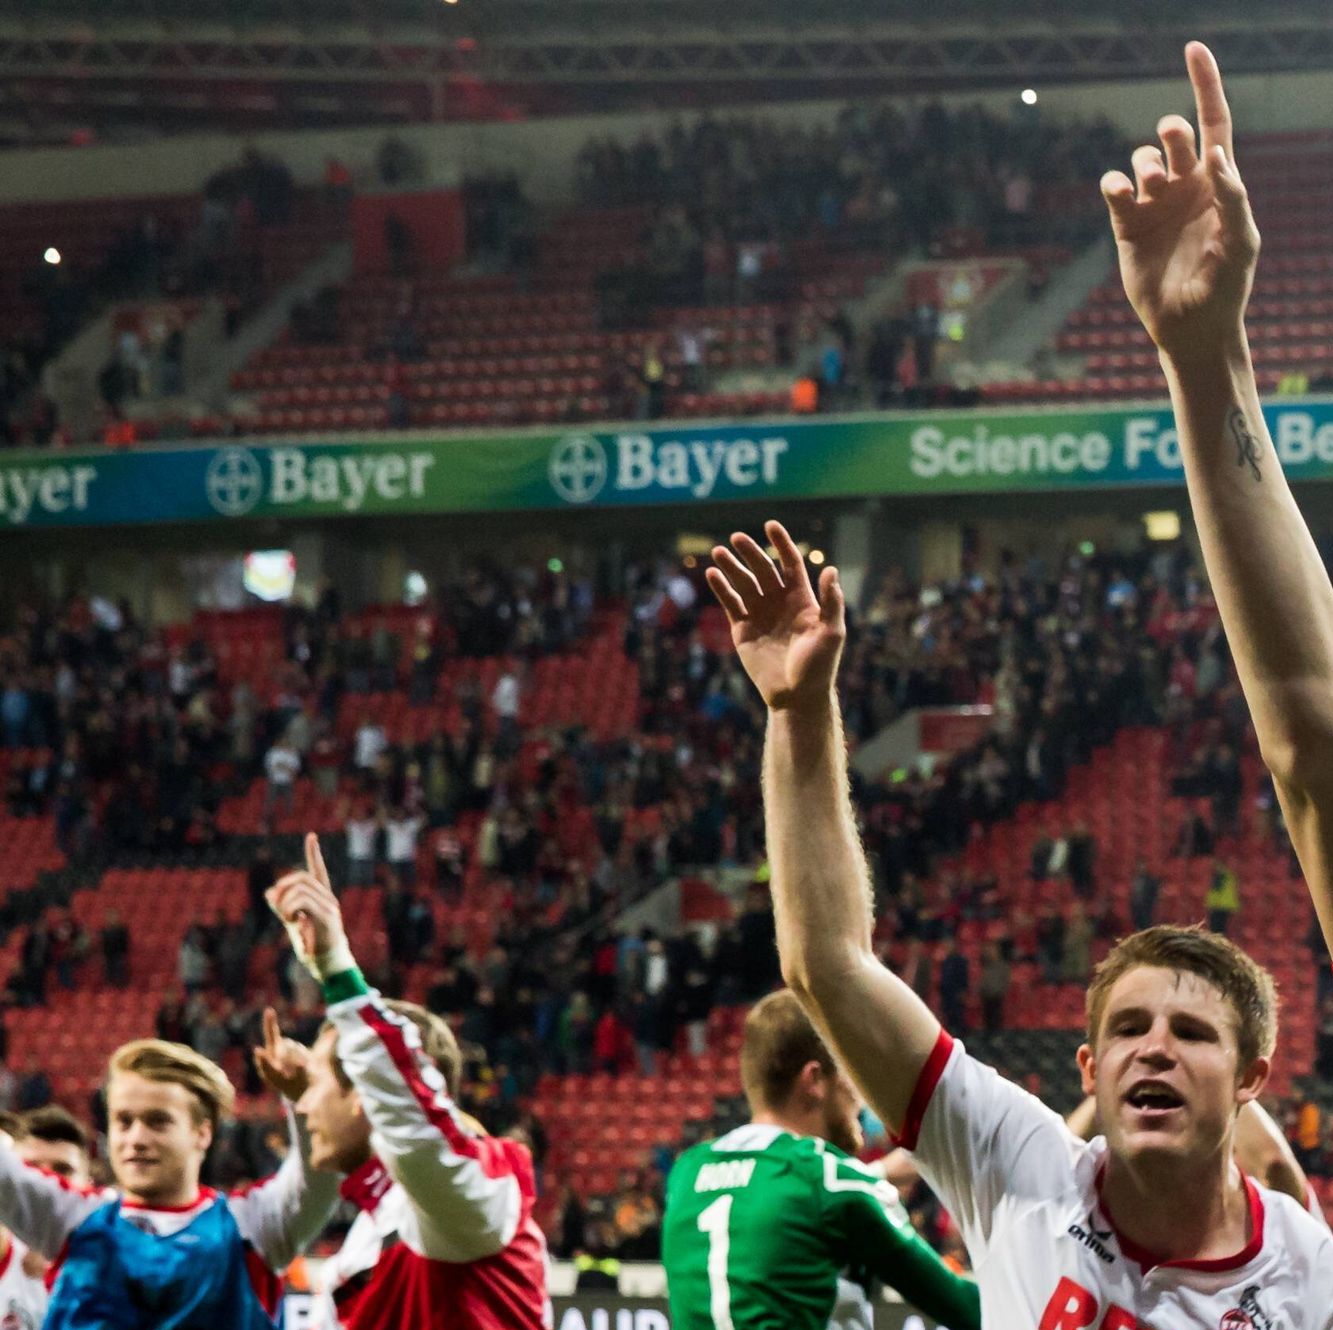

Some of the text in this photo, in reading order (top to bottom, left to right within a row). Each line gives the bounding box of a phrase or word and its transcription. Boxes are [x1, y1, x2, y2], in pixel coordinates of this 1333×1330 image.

[617, 432, 787, 497] Bayer
[910, 425, 1110, 477] Science
[1124, 418, 1183, 469] Fo
[0, 464, 97, 523] yer
[267, 447, 434, 510] Bayer
[1068, 1224, 1116, 1263] erima
